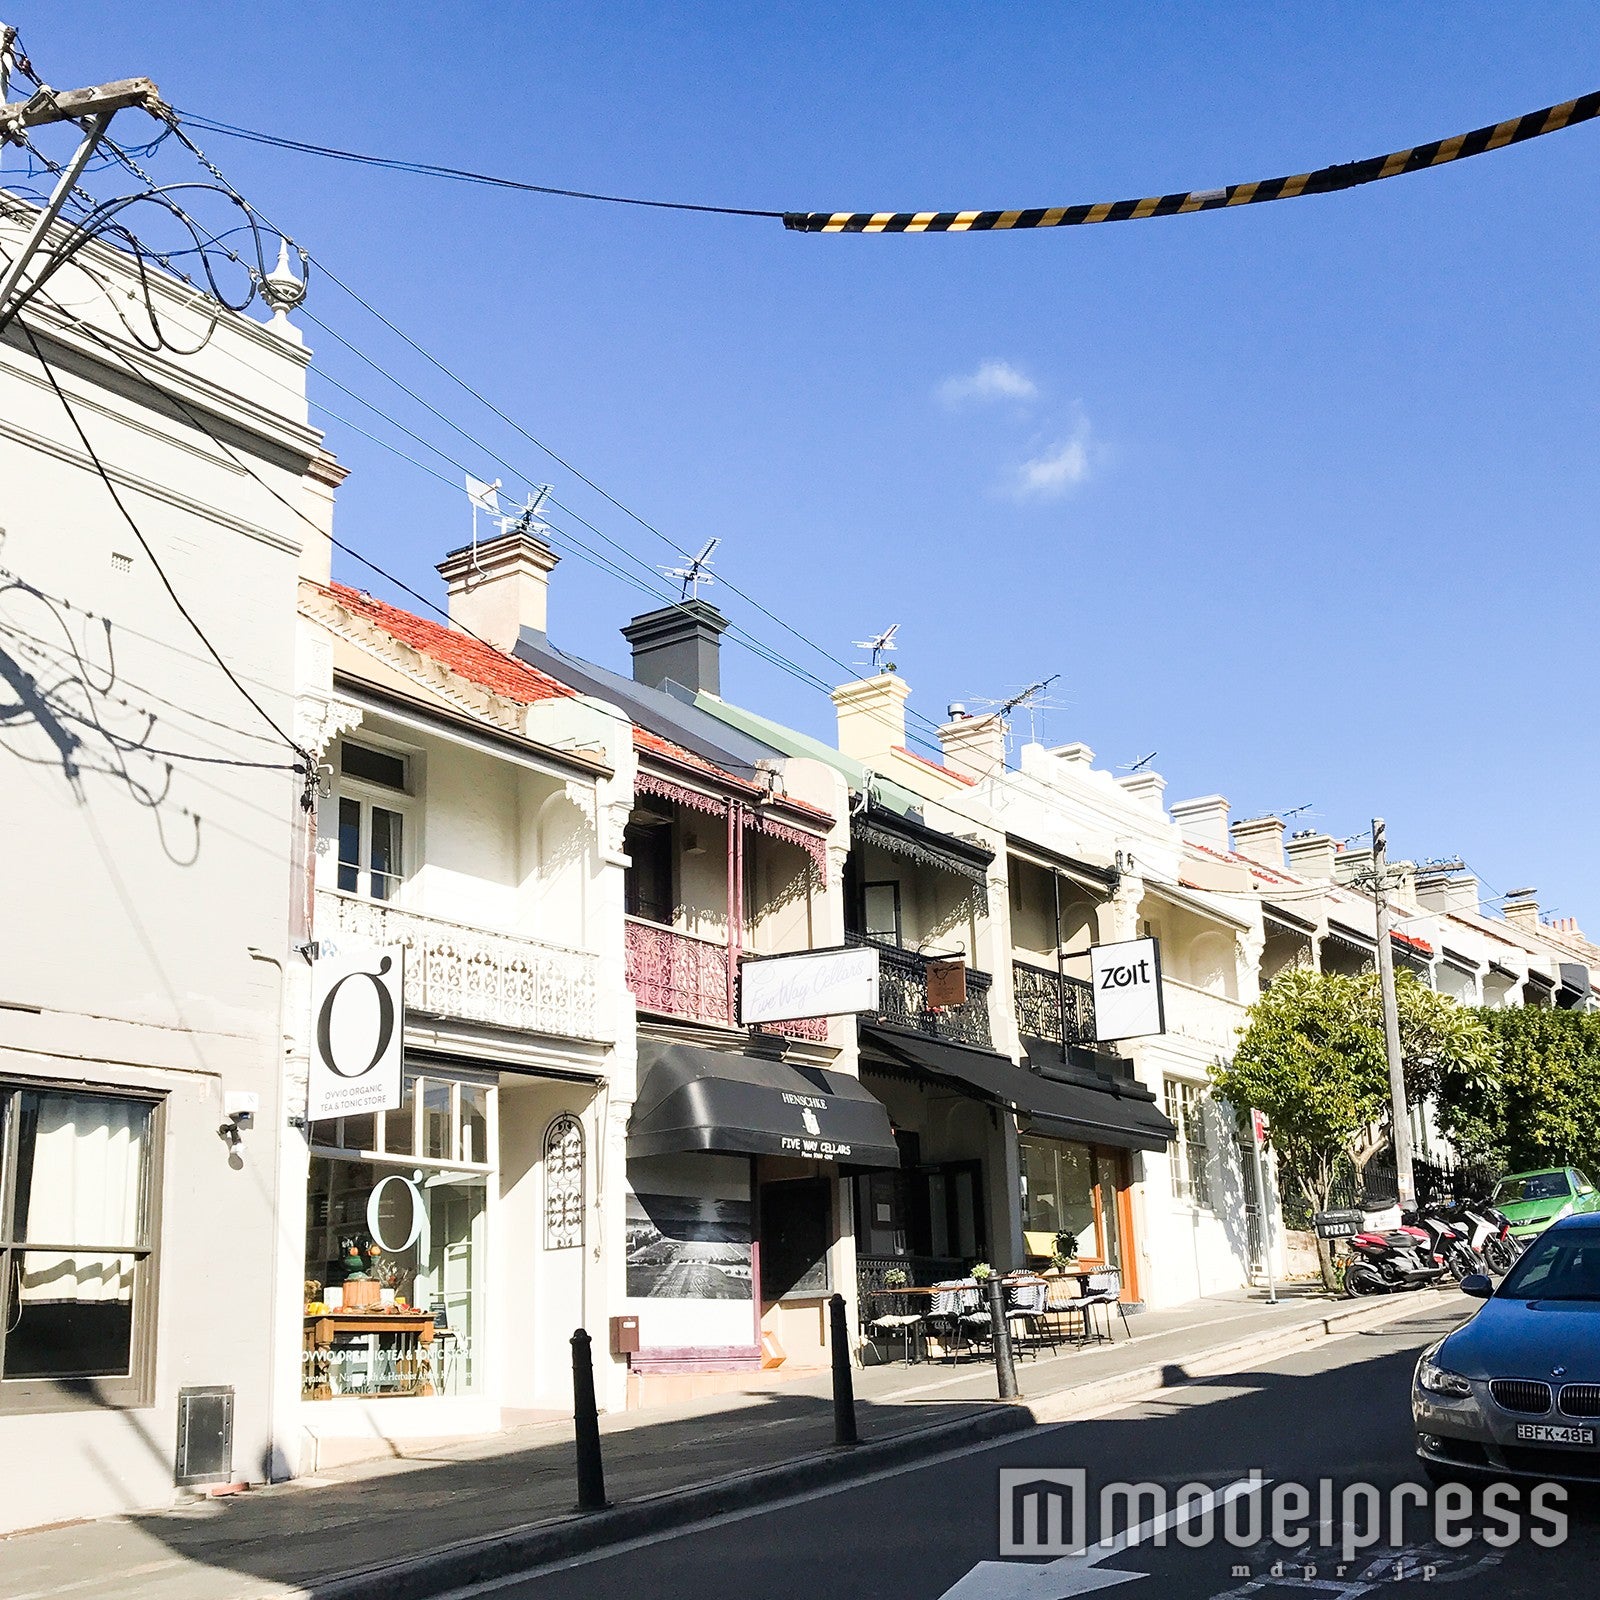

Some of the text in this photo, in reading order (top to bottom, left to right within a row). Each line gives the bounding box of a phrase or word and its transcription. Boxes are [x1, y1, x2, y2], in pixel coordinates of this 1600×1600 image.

[779, 974, 808, 1010] Way
[325, 1084, 383, 1100] OVVIO ORGANIC
[781, 1092, 828, 1110] HENSCHKE
[320, 1094, 387, 1112] TEA & TONIC STORE
[781, 1137, 852, 1156] FIVE WAY CELLARS
[1324, 1222, 1351, 1236] PIZZA
[301, 1350, 335, 1362] OVVIO
[388, 1349, 403, 1361] TEA
[405, 1349, 413, 1361] &
[415, 1349, 444, 1360] TONIC
